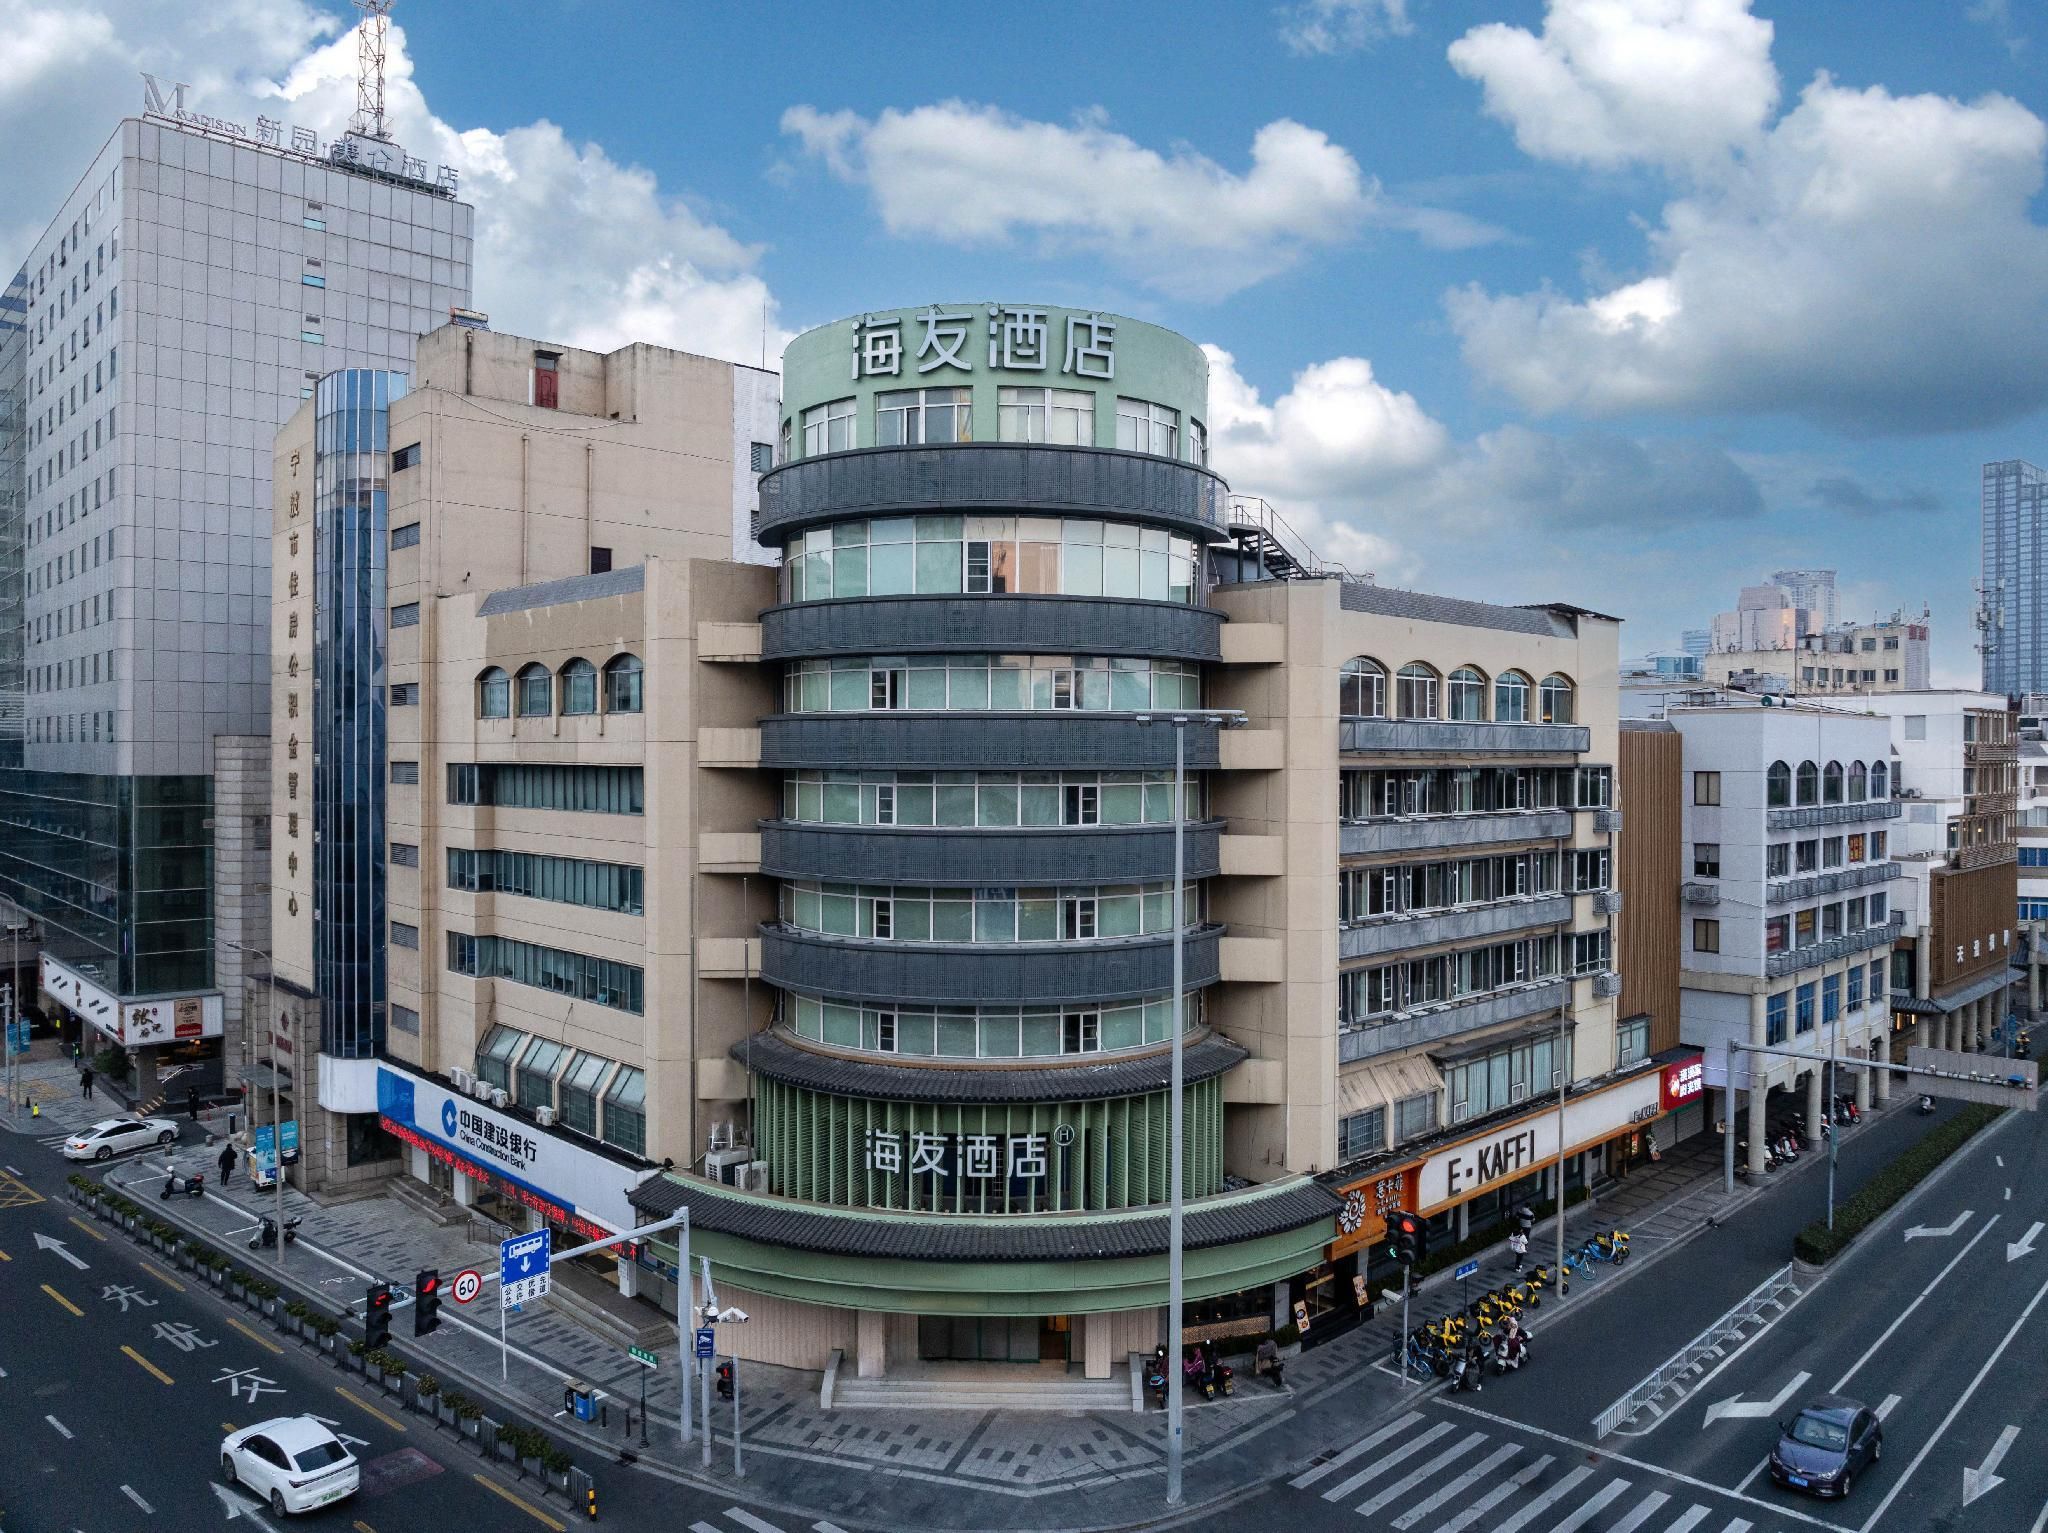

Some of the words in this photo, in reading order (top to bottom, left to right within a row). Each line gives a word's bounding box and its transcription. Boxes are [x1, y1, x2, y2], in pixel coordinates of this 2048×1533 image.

[851, 306, 1118, 380] 海友酒店
[459, 1129, 476, 1147] China
[475, 1137, 510, 1163] Construction
[510, 1153, 527, 1171] Bank
[460, 1109, 537, 1162] 中国建设银行
[865, 1128, 1047, 1179] 海友酒店
[1376, 1172, 1404, 1199] 意卡菲
[458, 1278, 475, 1296] 60
[504, 1275, 547, 1296] 公交优先
